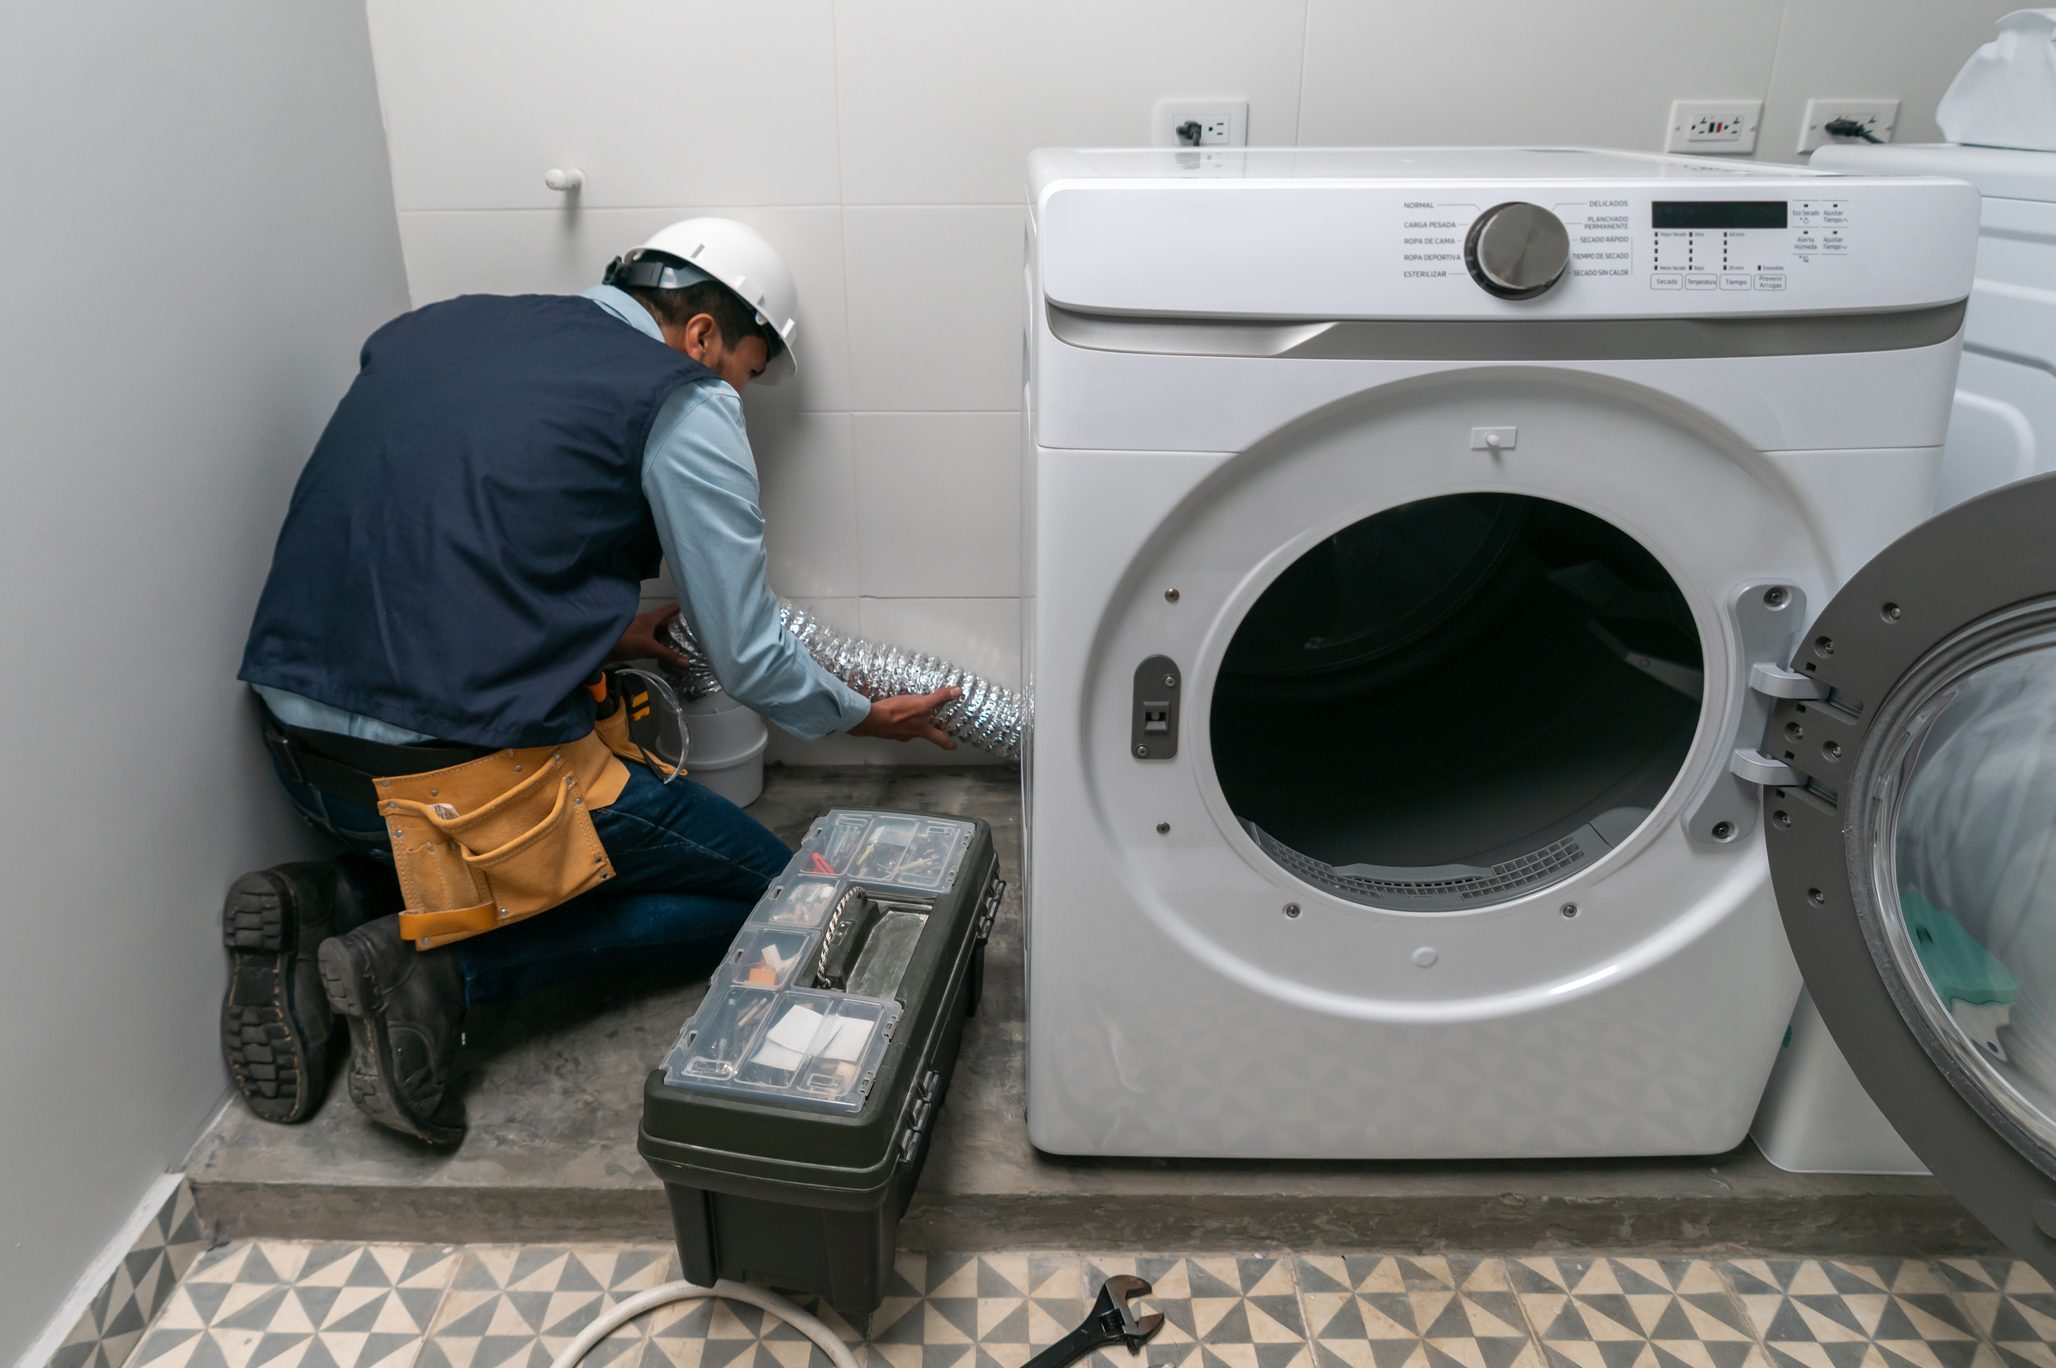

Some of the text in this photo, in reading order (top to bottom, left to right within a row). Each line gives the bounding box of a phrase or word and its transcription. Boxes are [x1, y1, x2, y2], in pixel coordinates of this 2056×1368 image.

[1605, 235, 1629, 243] RÁPIDO
[1572, 252, 1629, 260] TIEMPO DE SECADO
[1573, 269, 1629, 277] SECADO SIN CALOR
[1759, 281, 1782, 289] Arrugas
